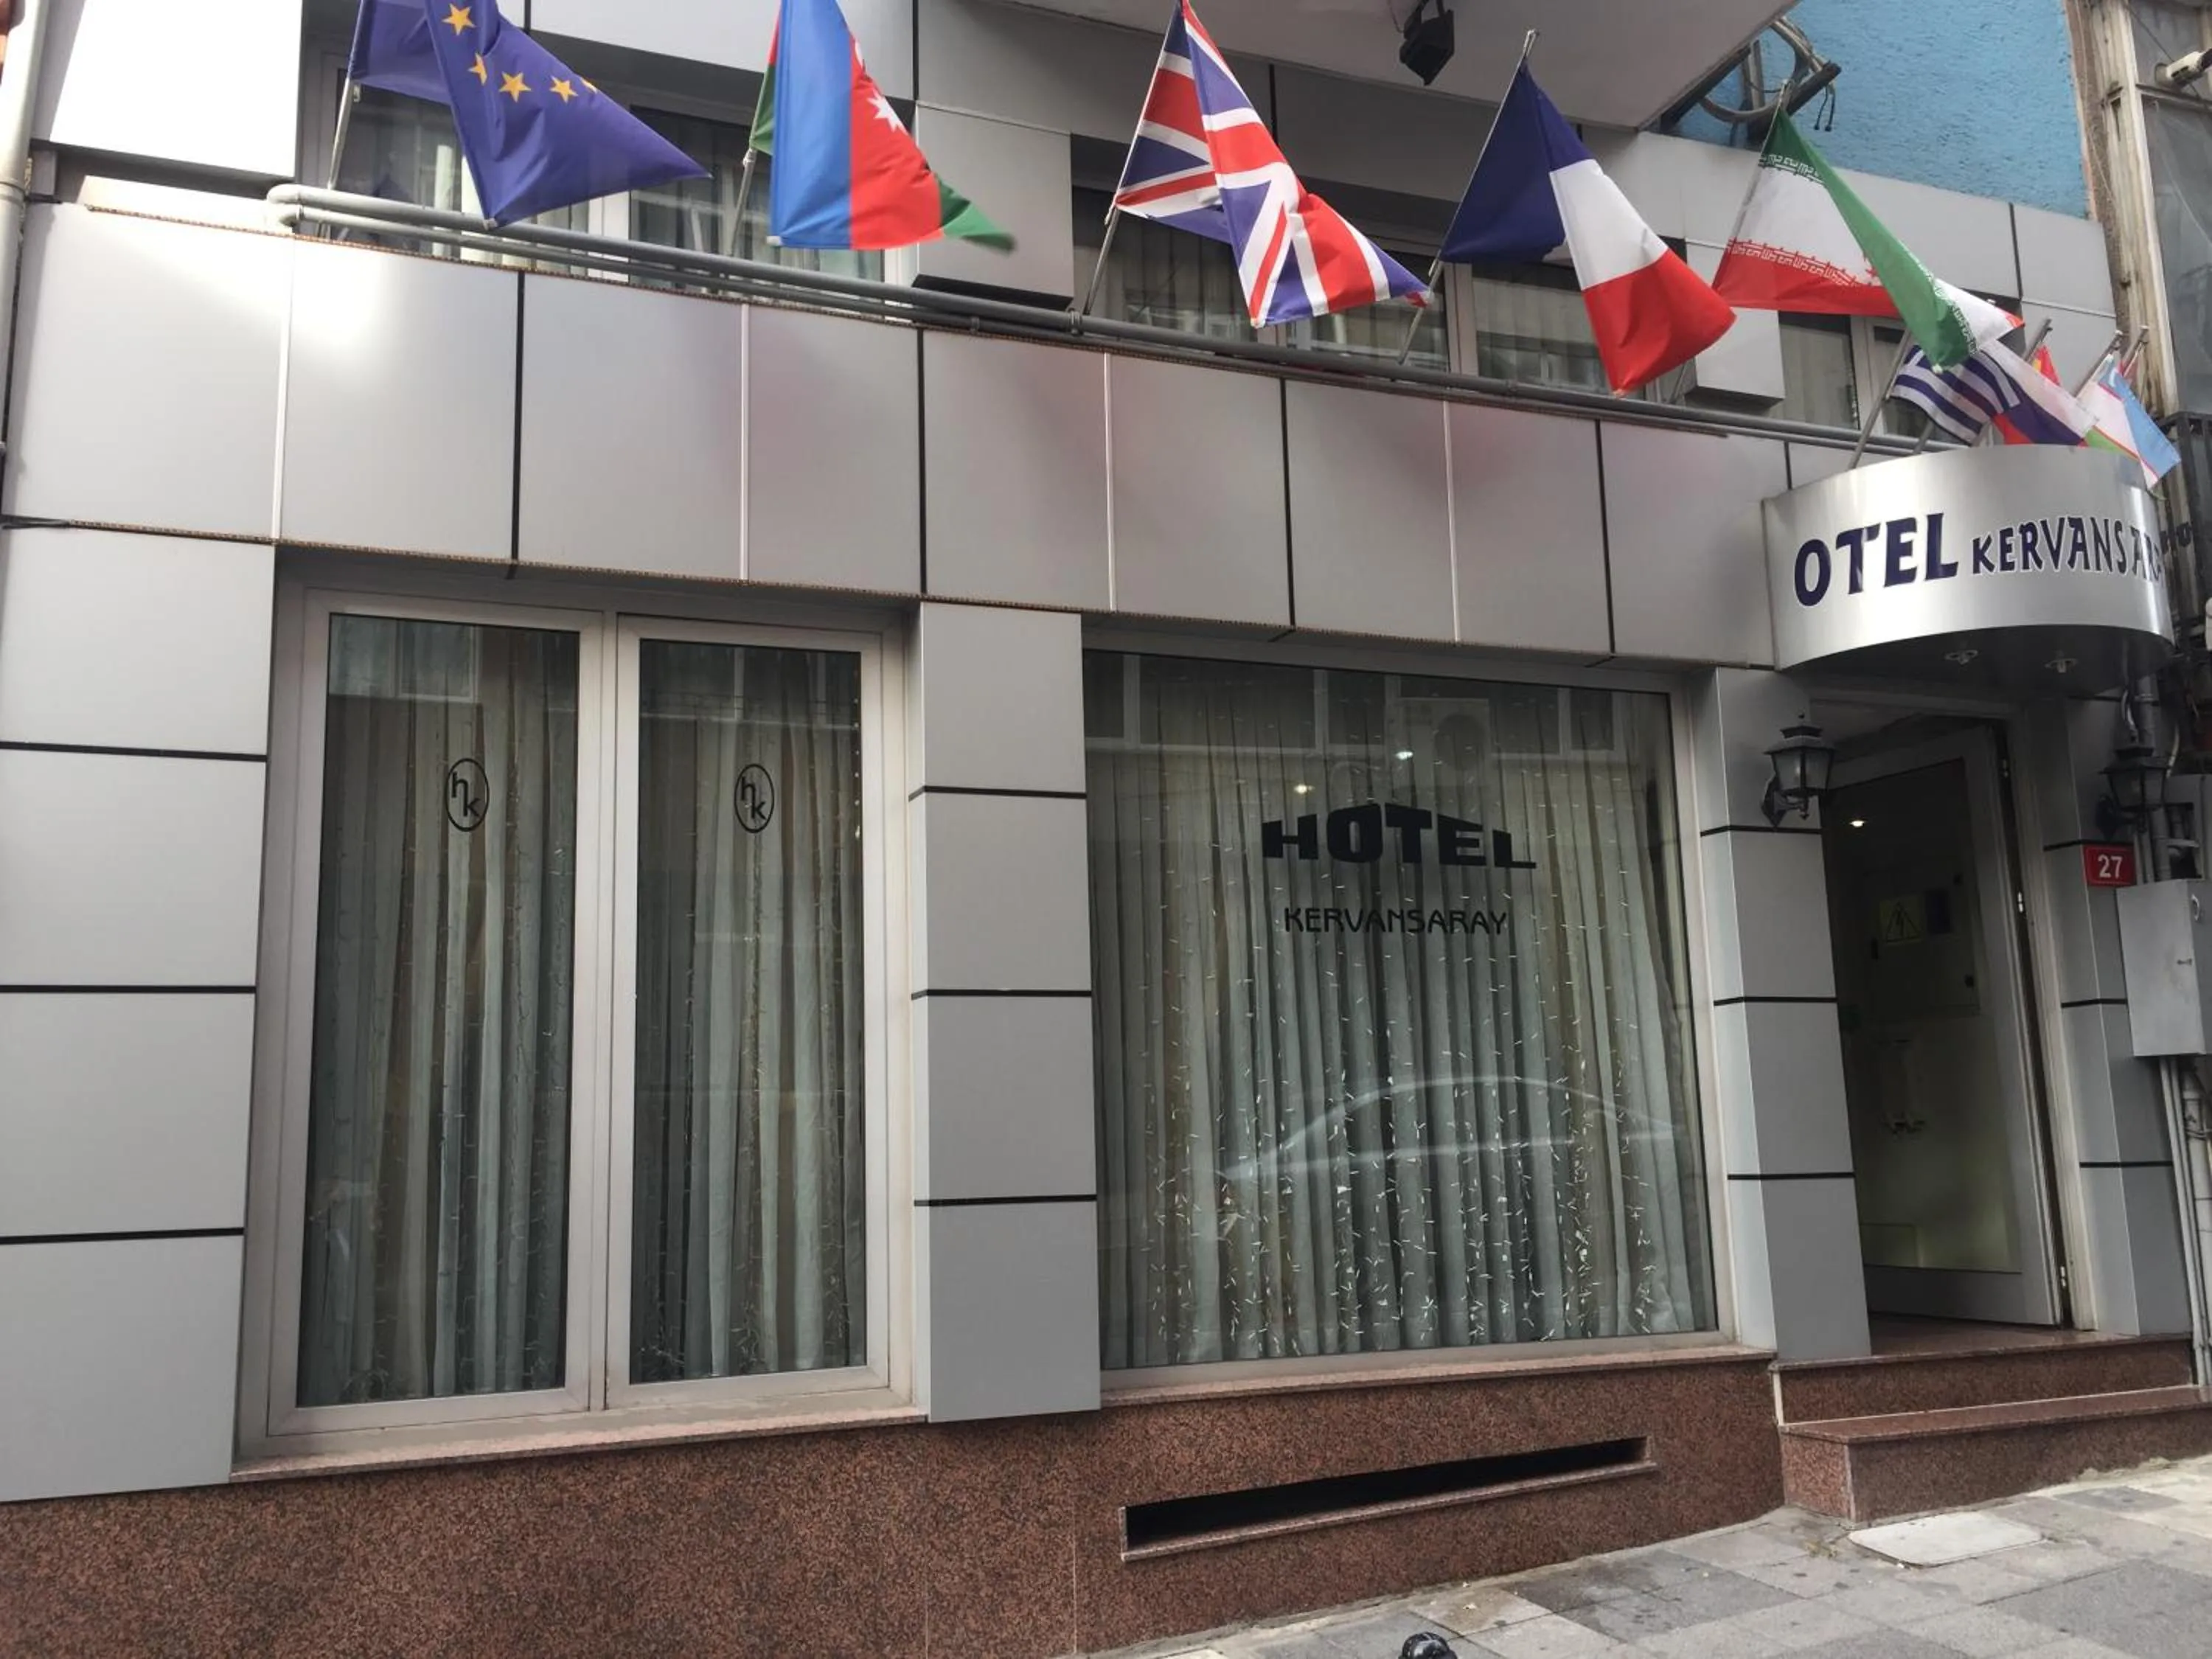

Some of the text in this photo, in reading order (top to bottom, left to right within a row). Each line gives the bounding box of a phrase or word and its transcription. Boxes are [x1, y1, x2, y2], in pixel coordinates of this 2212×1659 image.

[1794, 513, 1958, 606] OTEL
[1262, 802, 1537, 869] HOTEL
[2098, 855, 2123, 879] 27
[1284, 908, 1506, 934] KERVANSARAY
